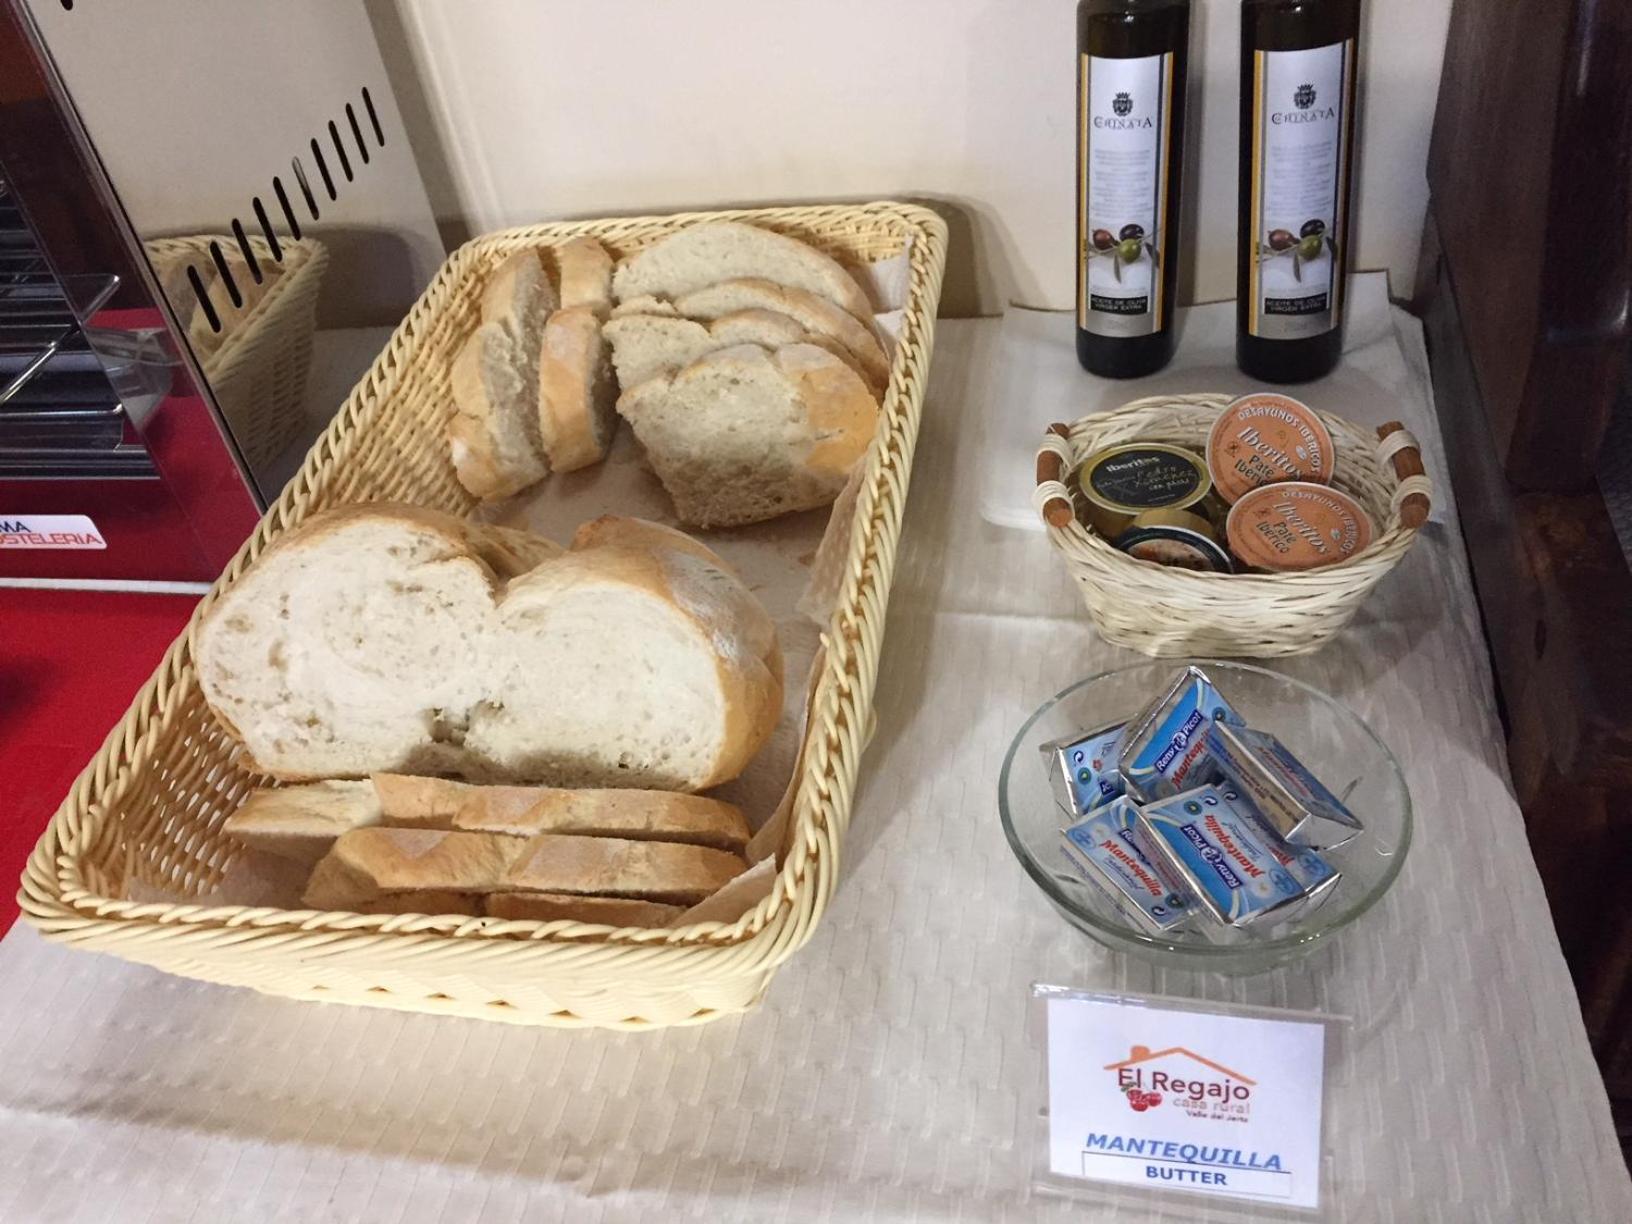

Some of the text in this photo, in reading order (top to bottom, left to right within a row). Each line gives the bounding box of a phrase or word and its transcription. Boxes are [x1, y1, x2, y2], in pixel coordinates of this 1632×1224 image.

[1239, 407, 1300, 427] DESAYUNOS
[1234, 458, 1266, 486] Iberi
[1156, 711, 1203, 772] Reny Picot
[1204, 814, 1266, 878] Mantequilla
[1099, 839, 1163, 897] Mantequilla
[1216, 863, 1240, 889] Reny
[1118, 1067, 1250, 1104] El Regajo
[1172, 1098, 1250, 1114] casa rural
[1085, 1132, 1282, 1170] MANTEQUILLA
[1145, 1165, 1228, 1186] BUTTER
